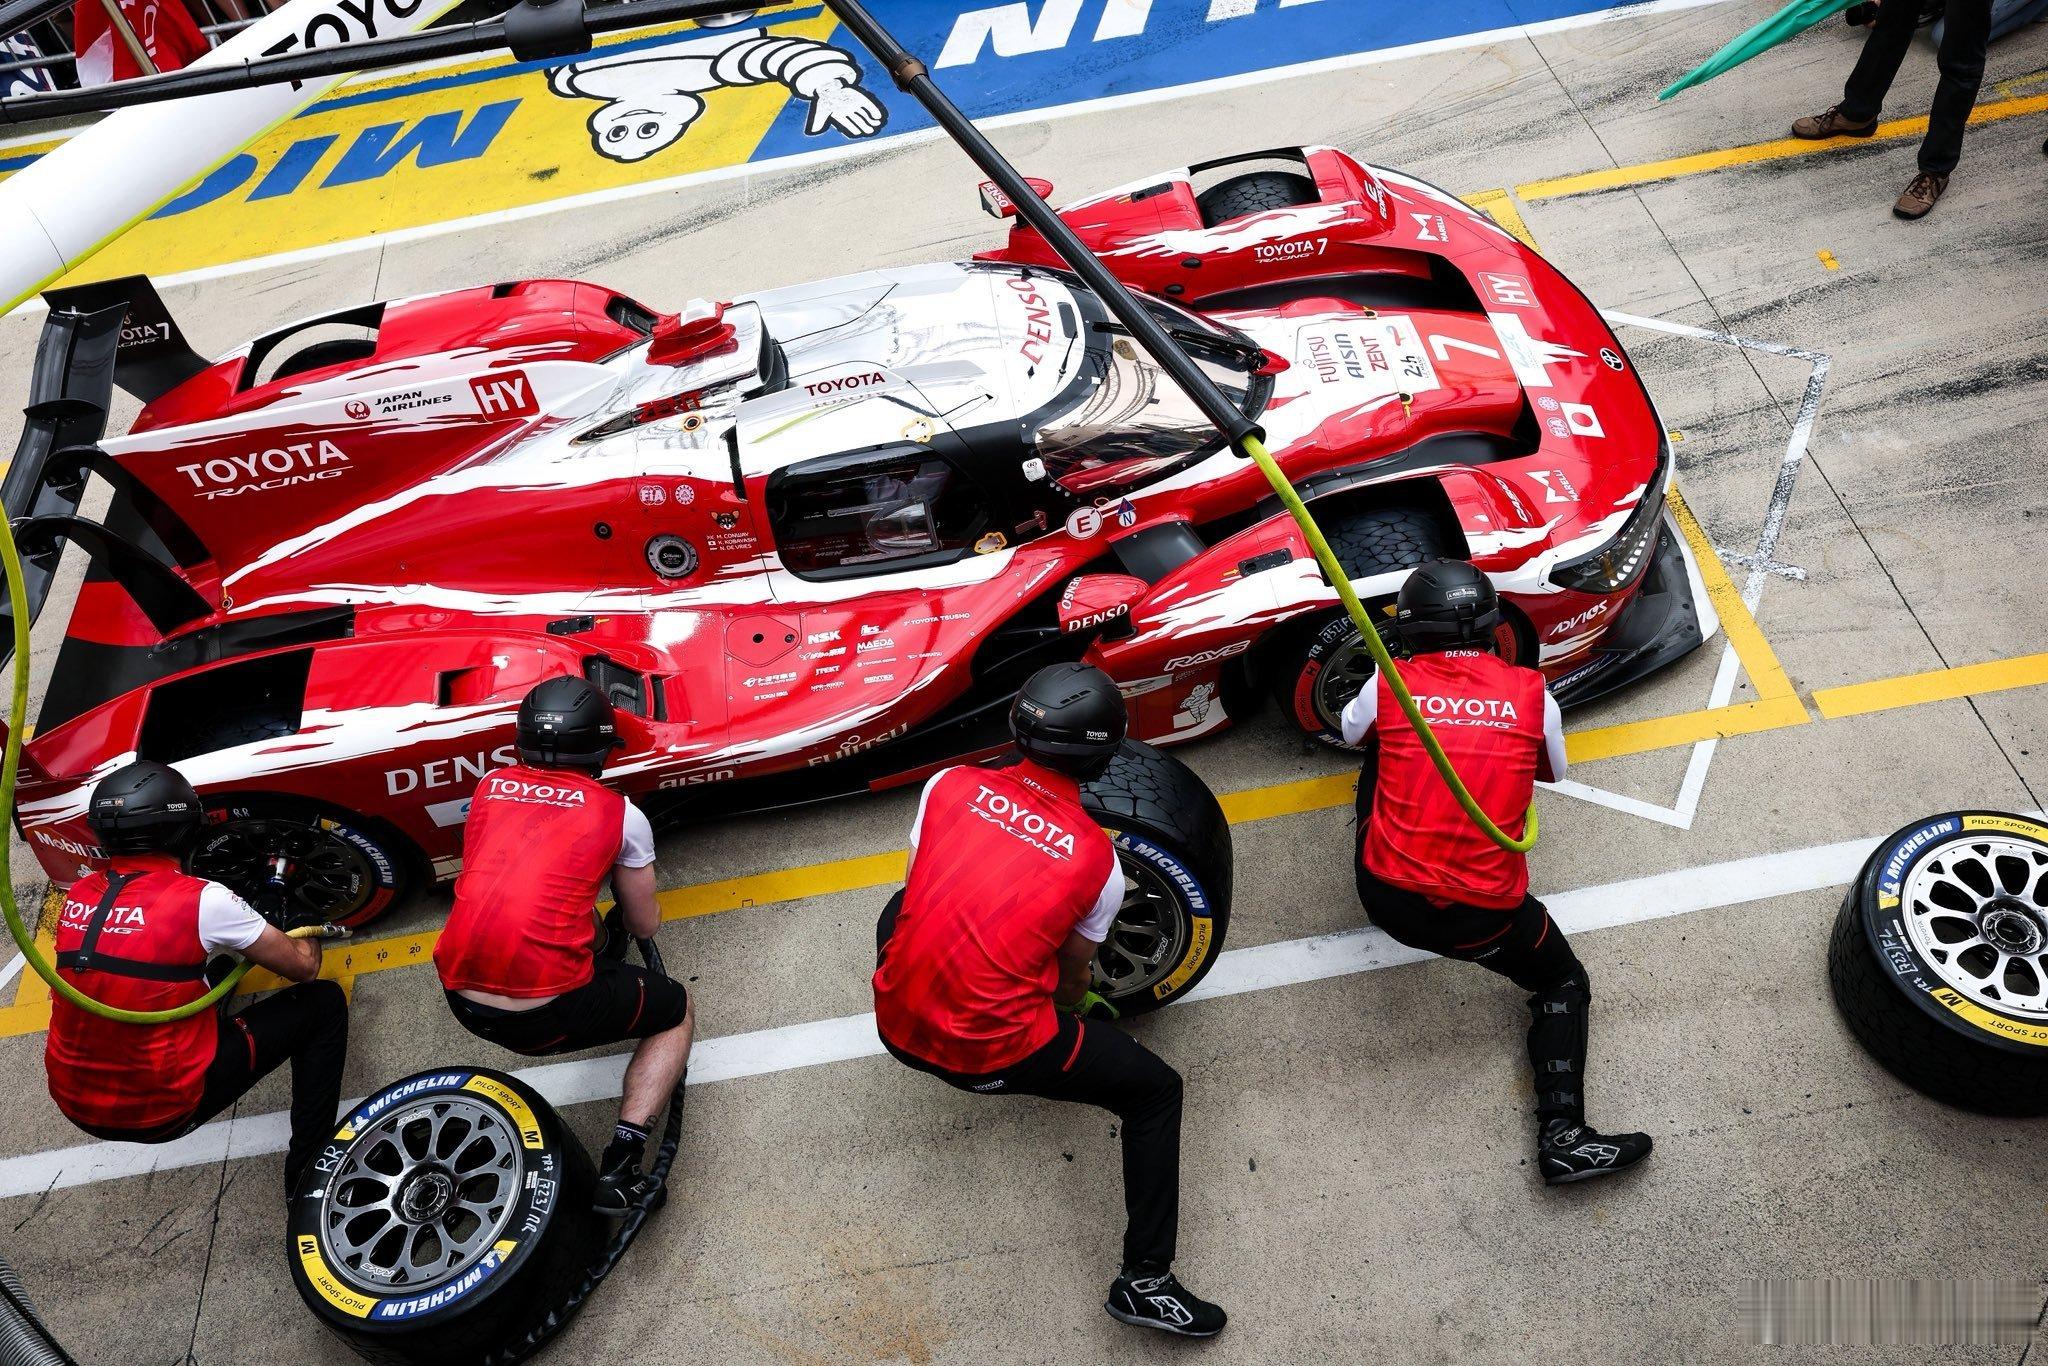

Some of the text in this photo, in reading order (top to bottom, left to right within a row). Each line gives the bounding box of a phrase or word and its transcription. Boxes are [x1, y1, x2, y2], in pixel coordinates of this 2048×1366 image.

[983, 182, 1008, 207] DENSO
[1435, 215, 1449, 242] MARELLI
[1254, 238, 1328, 258] TOYOTA 7
[1255, 252, 1315, 264] RACING
[1487, 274, 1530, 305] HY
[155, 322, 170, 340] 7
[1005, 277, 1052, 366] DENSO
[1307, 336, 1340, 384] FUJITSU
[1334, 333, 1365, 379] AISIN
[1360, 336, 1389, 372] ZENT
[1428, 333, 1501, 361] 7
[474, 377, 526, 414] HY
[804, 371, 886, 397] TOYOTA
[375, 391, 422, 406] JAPAN
[382, 395, 452, 414] AIRLINES
[176, 439, 350, 488] TOYOTA
[193, 465, 354, 501] RACING
[1553, 469, 1581, 502] MARELLI
[1076, 515, 1093, 534] E
[1122, 514, 1133, 526] N
[1062, 576, 1083, 610] DENSO
[1068, 603, 1129, 632] DENSO
[807, 630, 842, 645] NSK
[857, 638, 895, 651] MAEDA
[1164, 640, 1251, 672] RAYS
[1445, 650, 1480, 659] DENSO
[1411, 696, 1518, 720] TOYOTA
[808, 722, 908, 767] FUJITSU
[490, 778, 586, 804] TOYOTA
[658, 769, 734, 791] AISIN
[484, 793, 584, 809] RACING
[966, 802, 1071, 861] RACING
[975, 784, 1077, 856] TOYOTA
[1970, 817, 2040, 834] PILOT SPORT
[34, 830, 88, 858] Mobil
[1886, 820, 1953, 880] MICHELIN
[347, 832, 394, 885] MICHELIN
[1133, 842, 1205, 910] MICHELIN
[408, 945, 422, 955] 20
[1186, 946, 1203, 971] SPORT
[1158, 980, 1173, 995] M
[1938, 992, 1963, 1007] M
[1988, 1019, 2029, 1036] SPORT
[368, 1074, 462, 1117] MICHELIN
[474, 1080, 523, 1111] PILOT SPORT
[972, 1079, 1005, 1091] TOYOTA
[523, 1129, 541, 1144] M
[314, 1144, 345, 1173] RR
[300, 1240, 316, 1255] M
[316, 1275, 367, 1311] PILOT SPORT
[381, 1266, 483, 1317] MICHELIN
